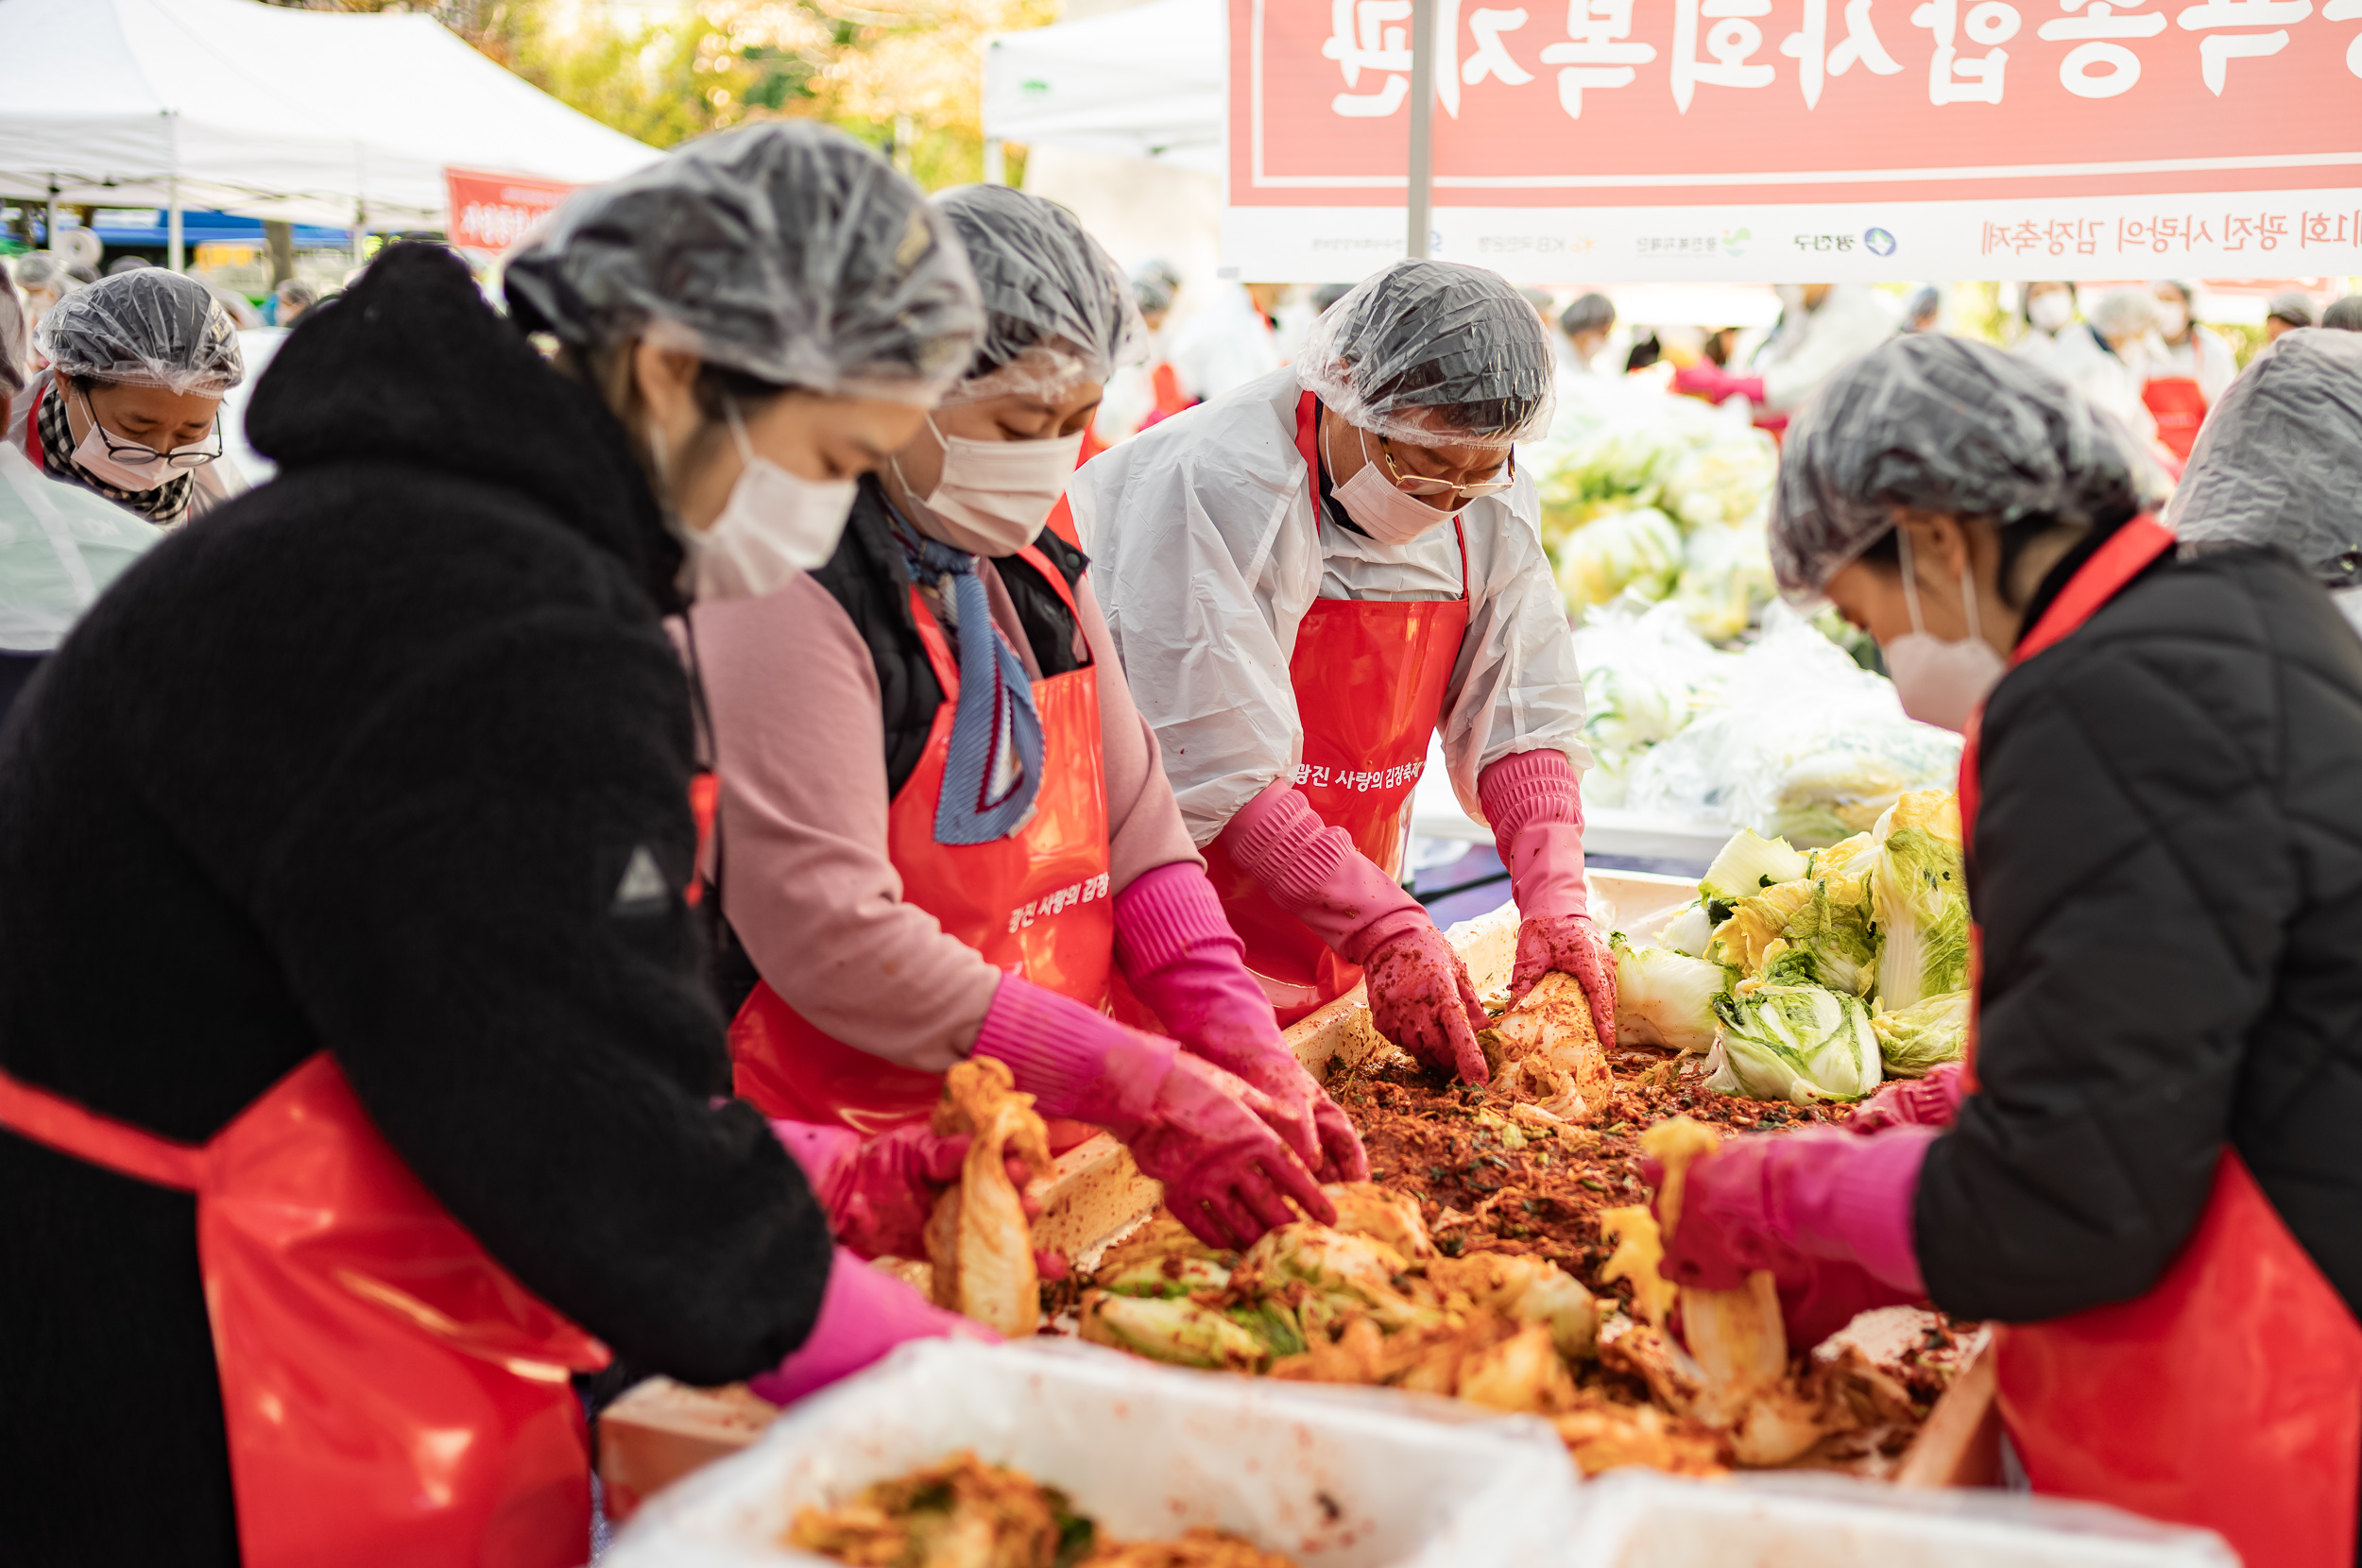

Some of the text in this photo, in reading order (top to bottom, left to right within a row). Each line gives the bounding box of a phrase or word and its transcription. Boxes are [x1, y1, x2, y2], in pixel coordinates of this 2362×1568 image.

[1295, 763, 1330, 787] 광진
[1335, 770, 1384, 793] 사랑의
[1008, 900, 1038, 934] 광진
[1037, 882, 1082, 916] 사랑의
